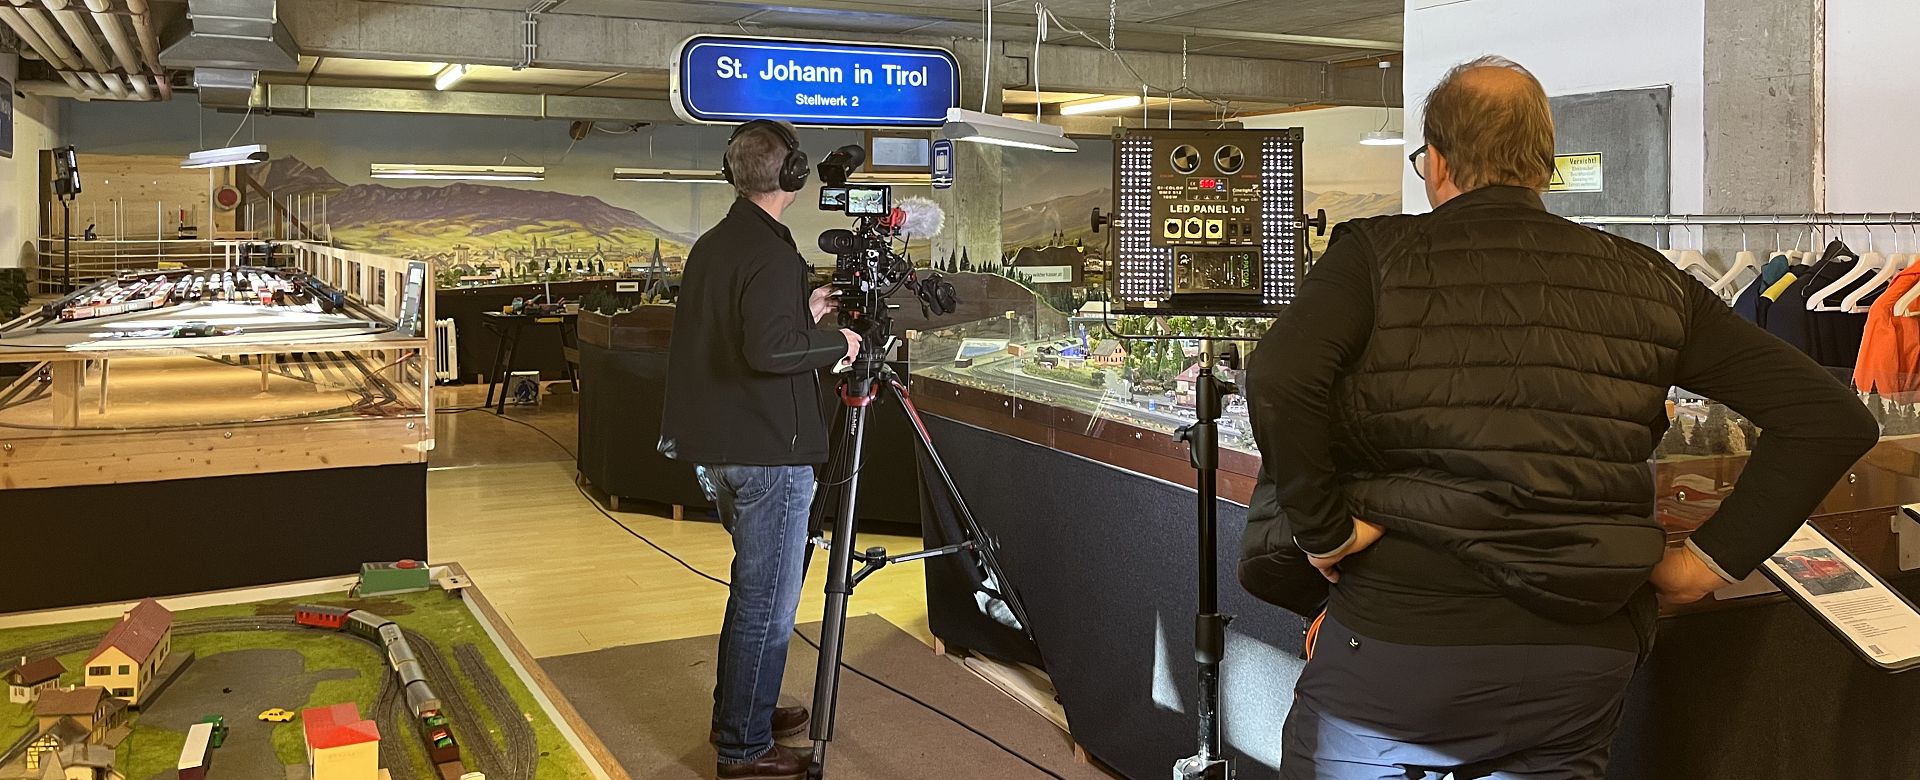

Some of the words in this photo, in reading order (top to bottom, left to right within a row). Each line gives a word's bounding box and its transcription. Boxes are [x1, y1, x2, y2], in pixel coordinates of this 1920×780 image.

[716, 56, 748, 79] St.
[759, 58, 843, 83] Johann
[854, 64, 873, 84] in
[881, 64, 927, 87] Tirol
[795, 94, 847, 107] Stellwerk
[851, 96, 859, 107] 2
[1170, 205, 1190, 213] LED
[1193, 205, 1229, 213] PANEL
[1231, 205, 1245, 214] 1x1
